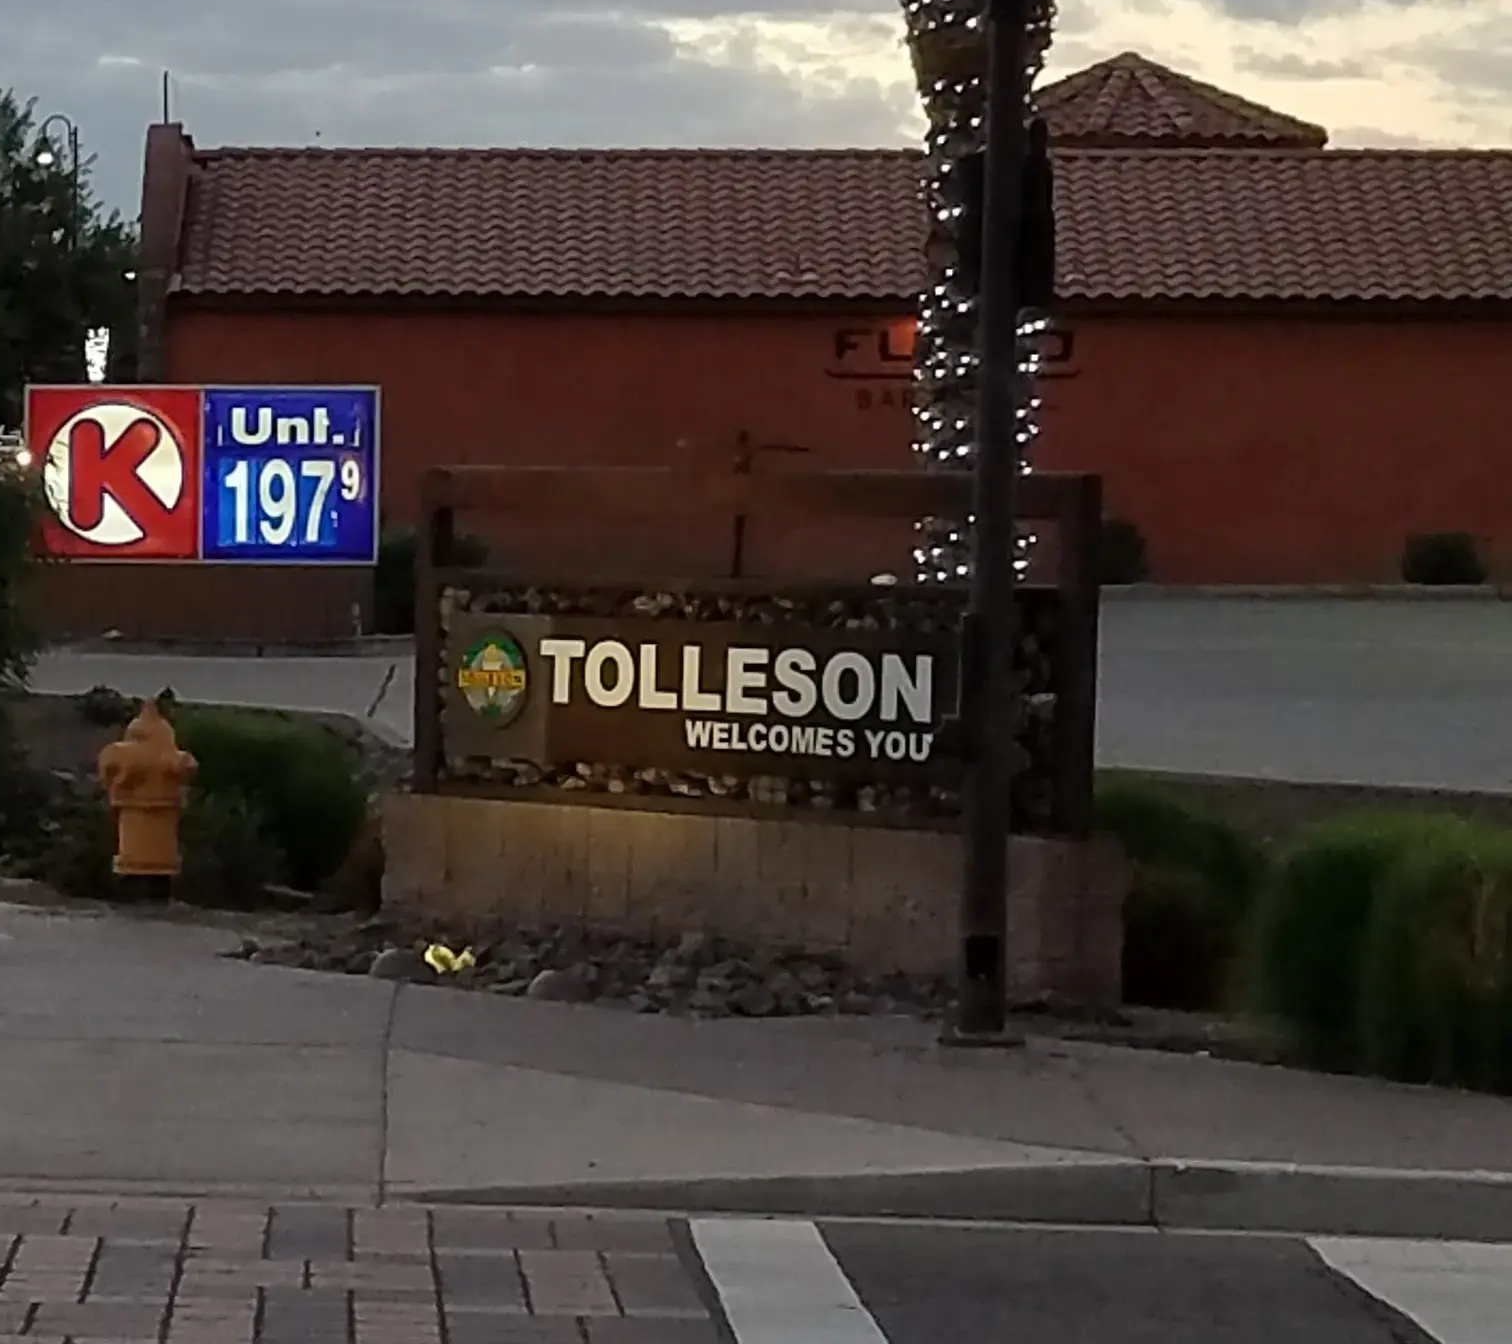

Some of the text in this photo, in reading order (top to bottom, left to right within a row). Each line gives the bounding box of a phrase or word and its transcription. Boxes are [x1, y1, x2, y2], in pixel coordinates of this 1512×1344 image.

[231, 407, 345, 445] Unl.
[68, 416, 176, 538] K
[540, 639, 933, 723] TOLLESON
[685, 719, 933, 762] WELCOMES YOU
